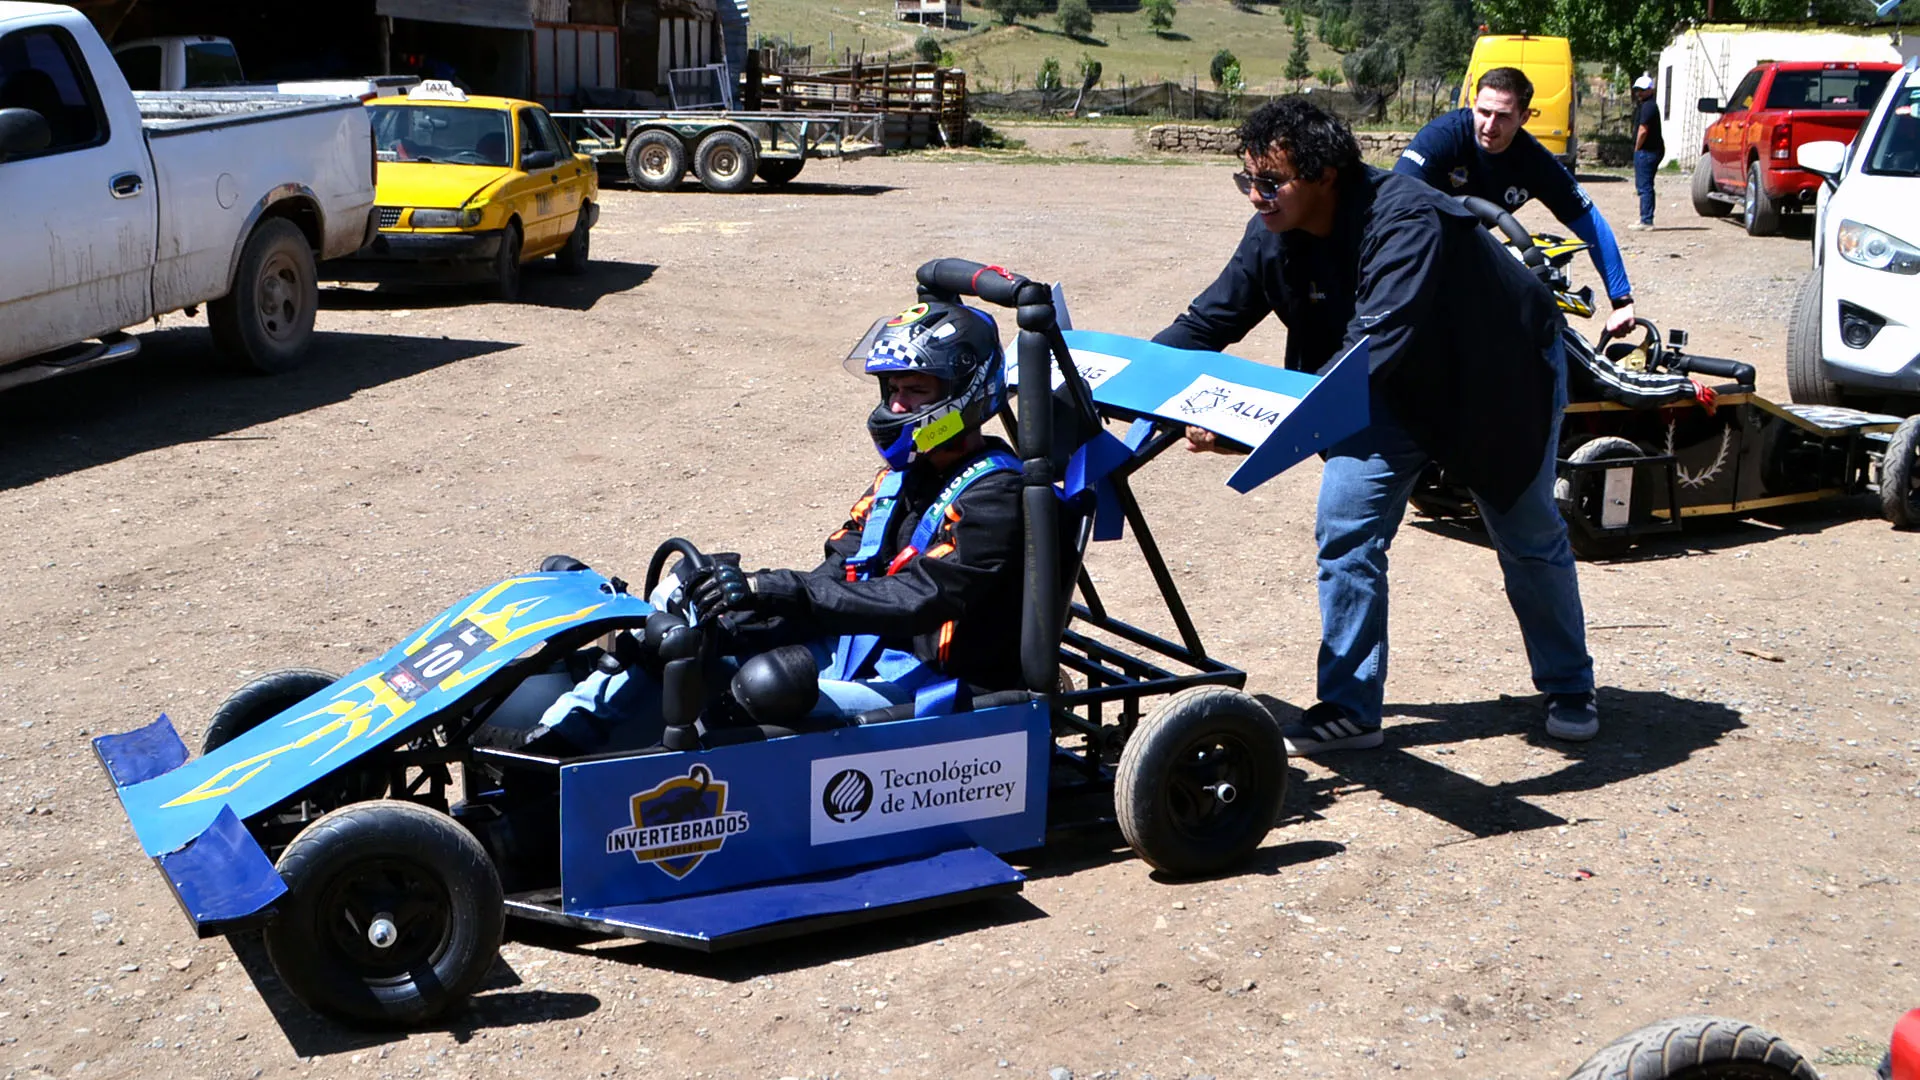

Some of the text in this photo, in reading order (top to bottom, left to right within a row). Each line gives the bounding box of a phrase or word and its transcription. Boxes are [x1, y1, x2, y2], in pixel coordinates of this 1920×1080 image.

[425, 82, 448, 92] TAXI
[1225, 401, 1280, 426] ALVA
[932, 459, 988, 516] SPORT
[413, 642, 464, 678] 10
[880, 757, 1002, 790] Tecnológico
[880, 781, 1017, 815] de Monterrey
[608, 813, 749, 852] INVERTEBRADOS
